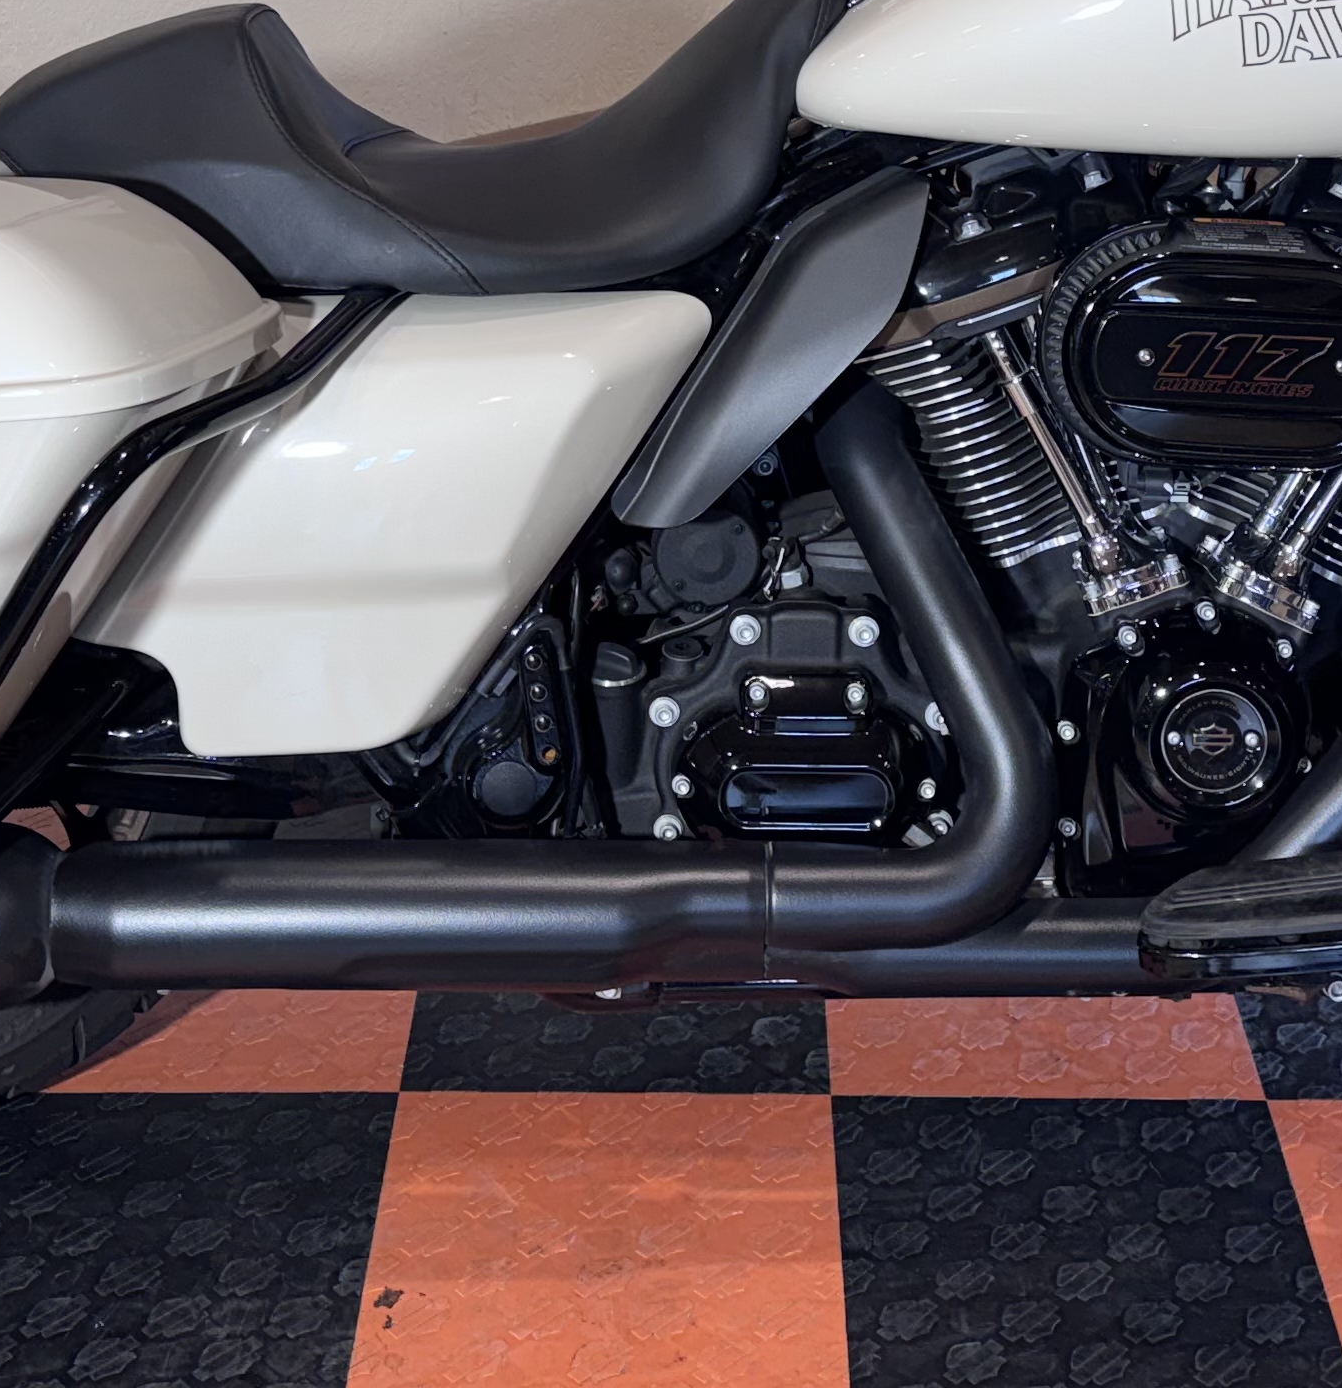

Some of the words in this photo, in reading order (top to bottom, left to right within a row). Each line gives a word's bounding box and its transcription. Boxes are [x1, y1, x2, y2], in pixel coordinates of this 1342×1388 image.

[1158, 331, 1335, 382] 117
[1153, 378, 1227, 393] CUBIC
[1226, 380, 1314, 398] INCHES
